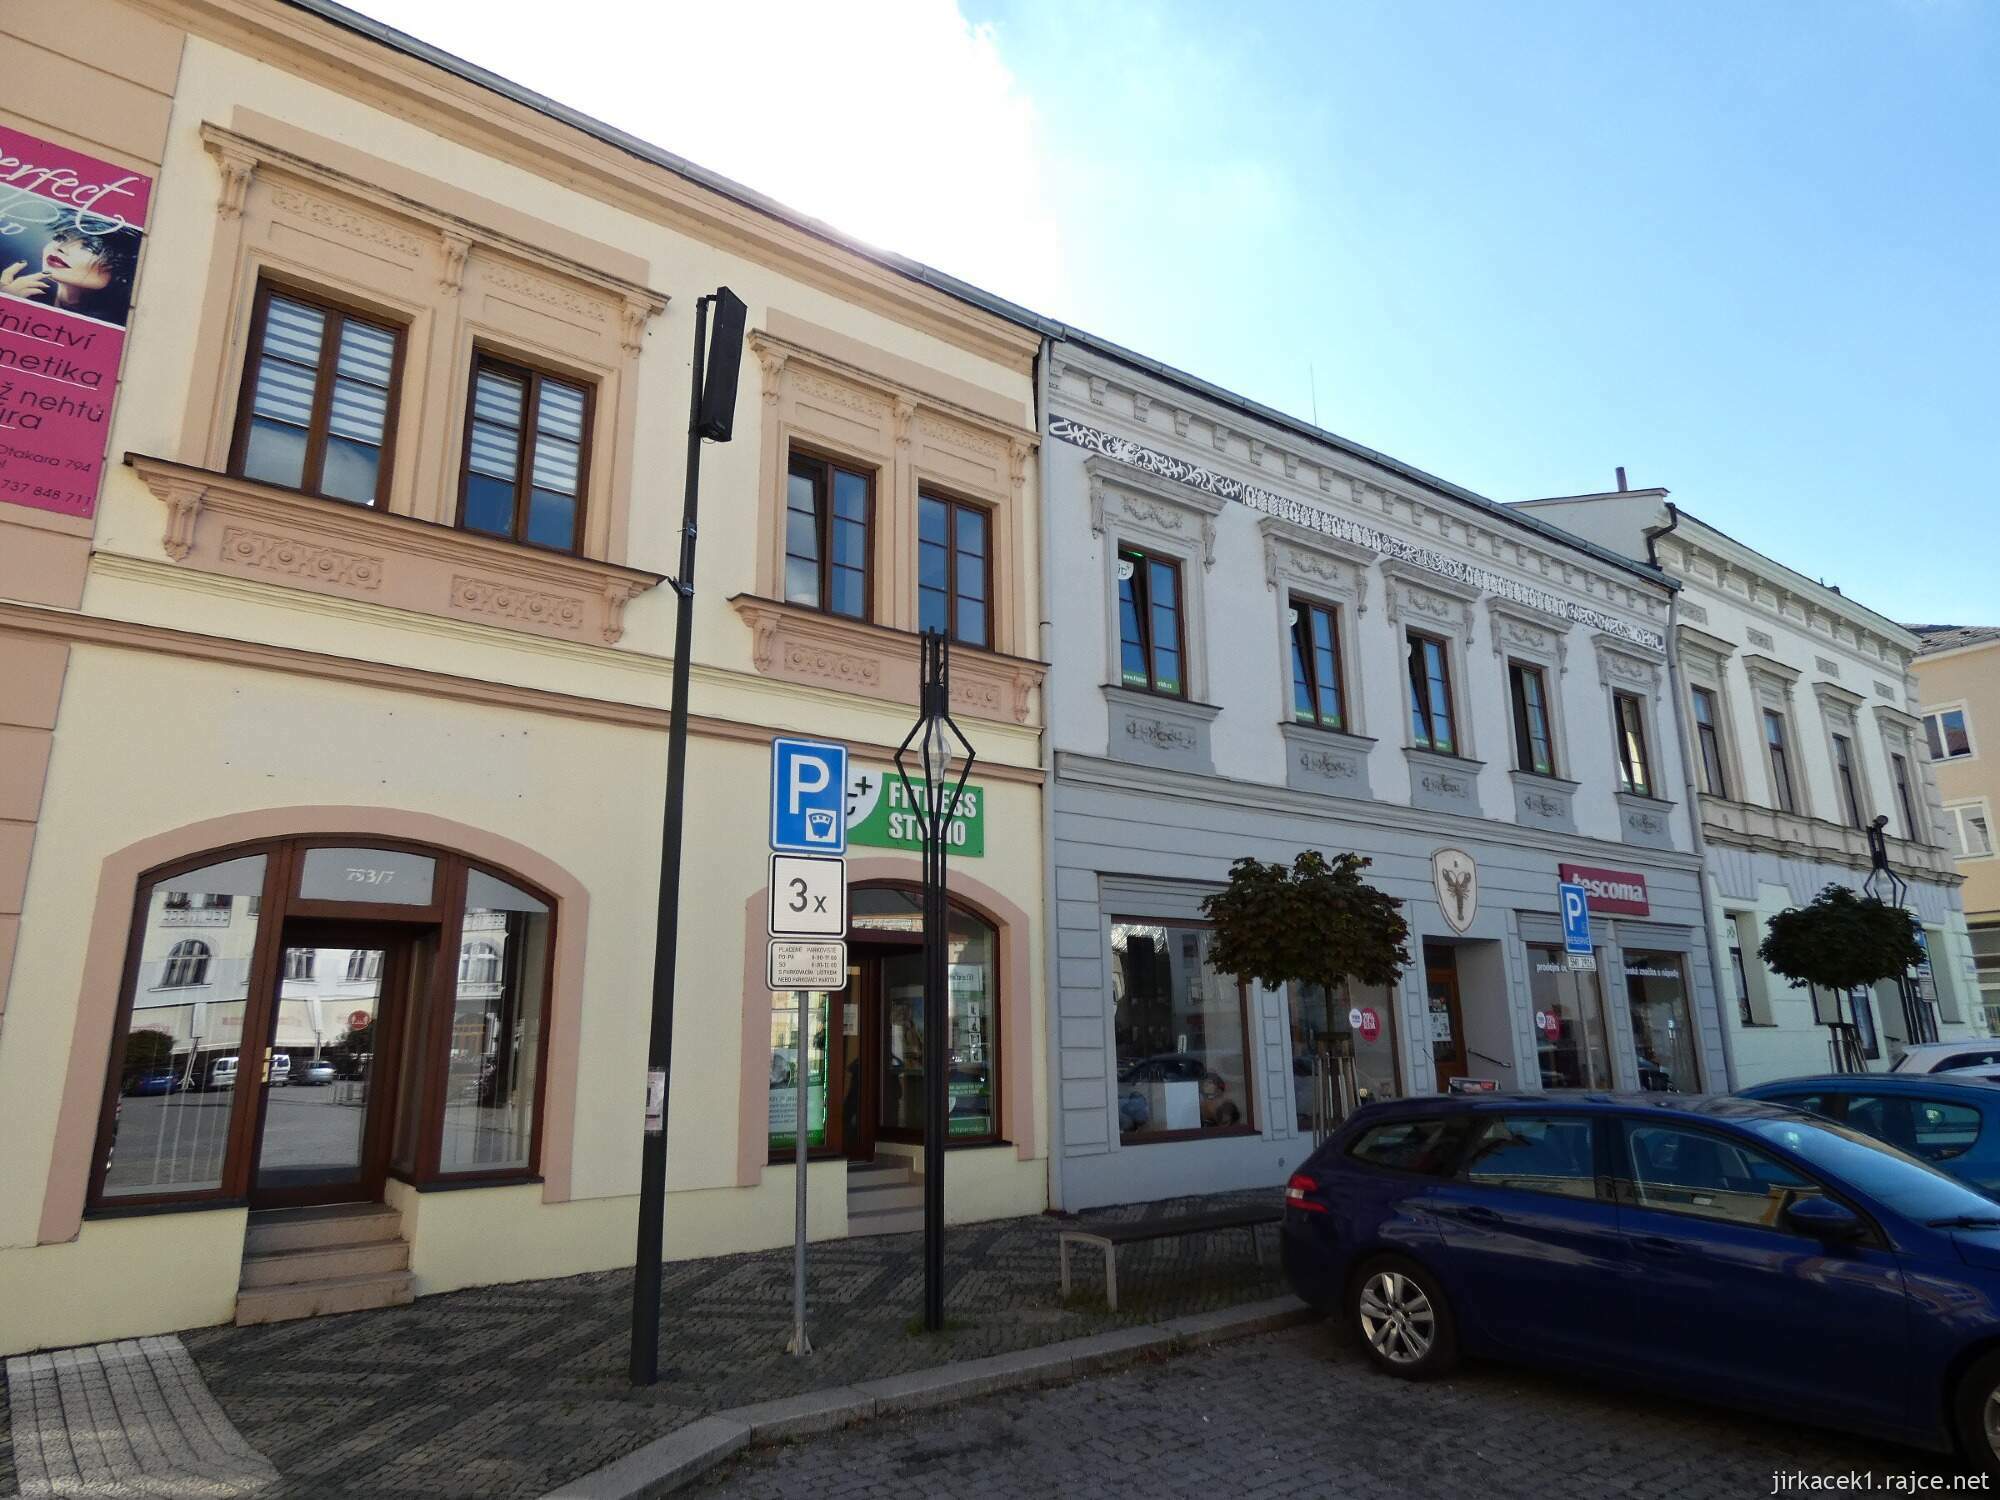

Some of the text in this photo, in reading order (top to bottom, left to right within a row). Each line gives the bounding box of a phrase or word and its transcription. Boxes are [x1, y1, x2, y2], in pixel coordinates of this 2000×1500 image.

[0, 148, 139, 236] erfect
[64, 459, 91, 472] 794
[1, 480, 30, 493] 737
[64, 492, 91, 506] 711
[789, 753, 830, 815] P
[1565, 892, 1582, 931] P
